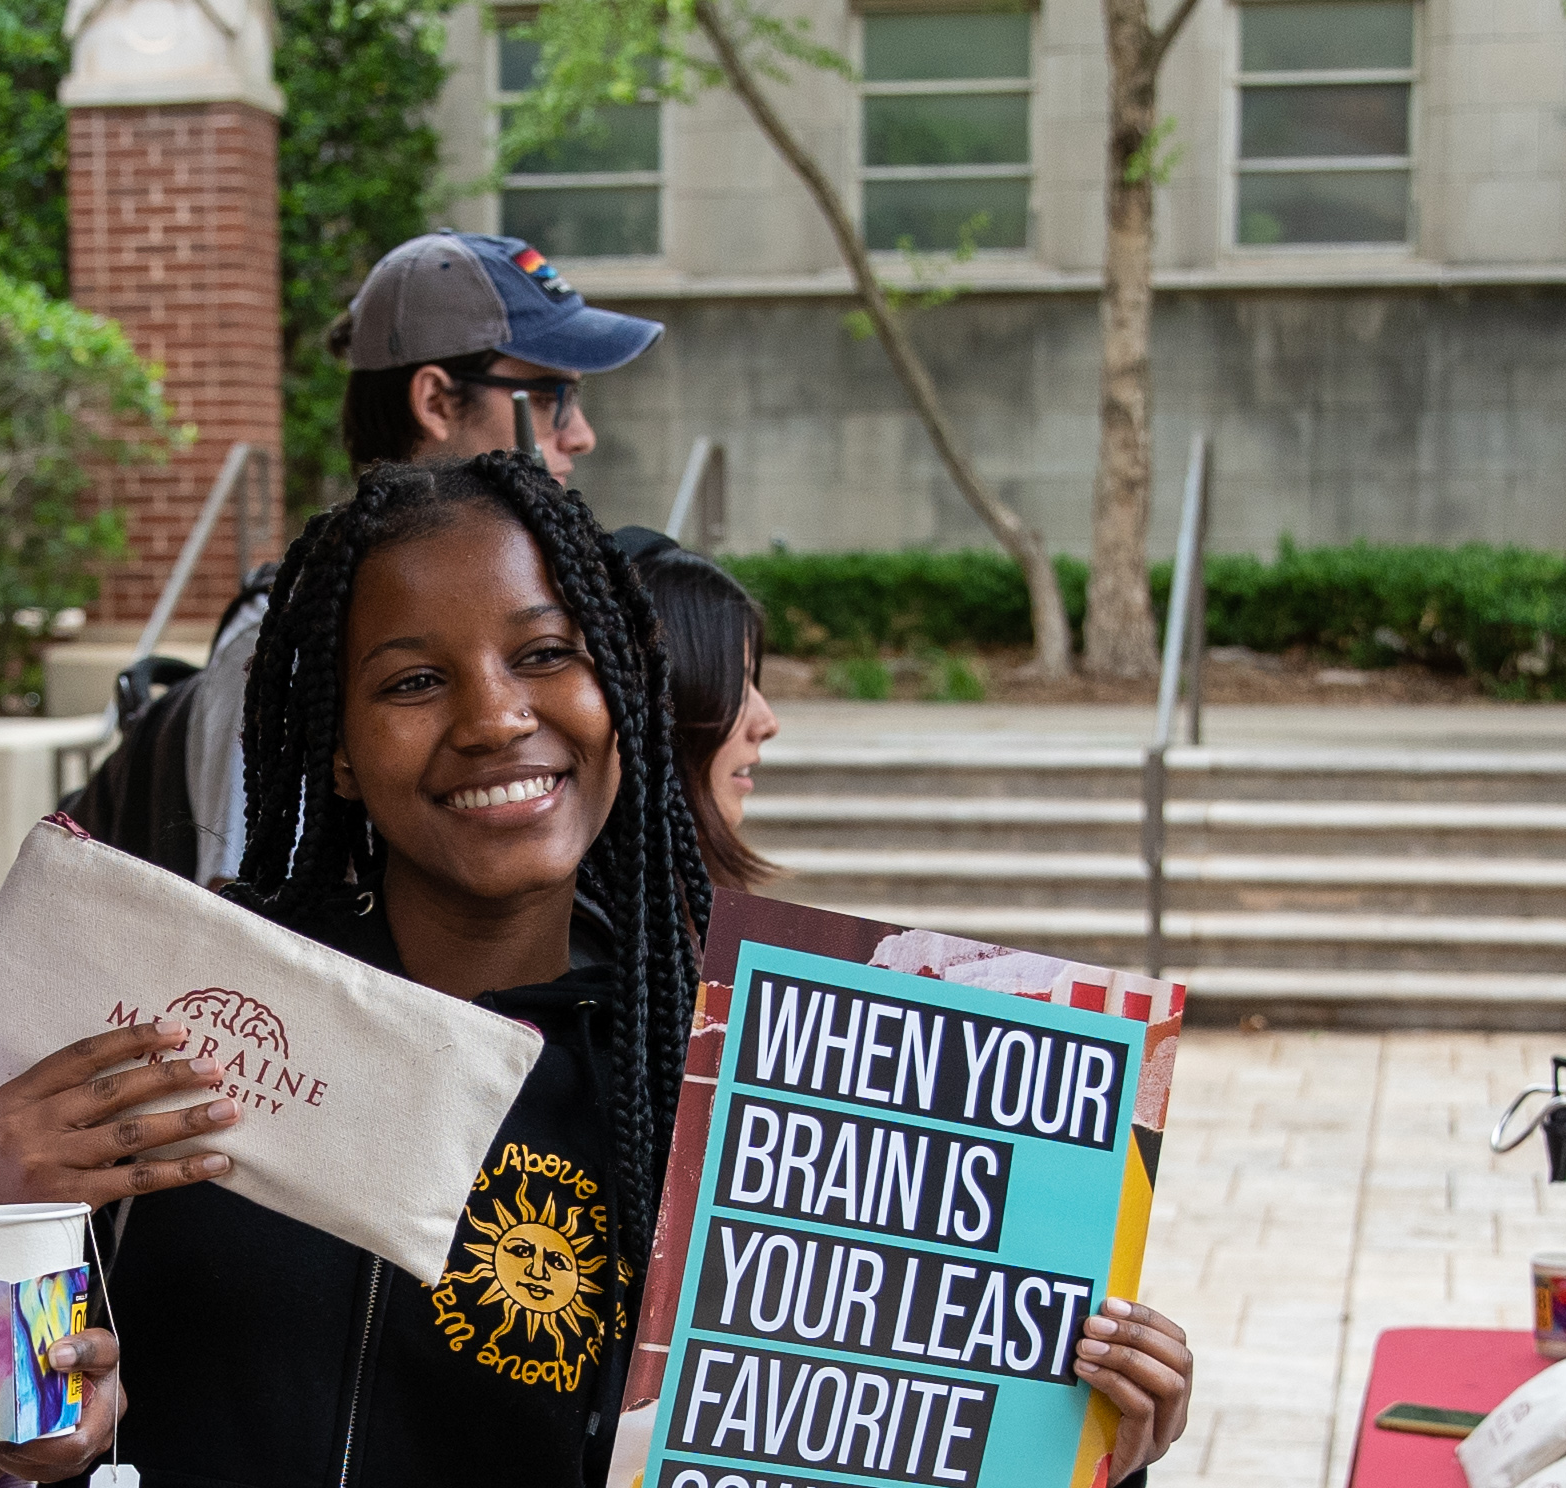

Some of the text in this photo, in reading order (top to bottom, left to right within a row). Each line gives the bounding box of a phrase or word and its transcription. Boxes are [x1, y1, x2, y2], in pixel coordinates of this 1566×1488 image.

[754, 980, 1117, 1143] WHEN YOUR
[493, 1143, 598, 1199] Above
[730, 1105, 999, 1245] BRAIN IS
[720, 1228, 1088, 1378] YOUR LEAST
[681, 1349, 984, 1480] FAVORITE
